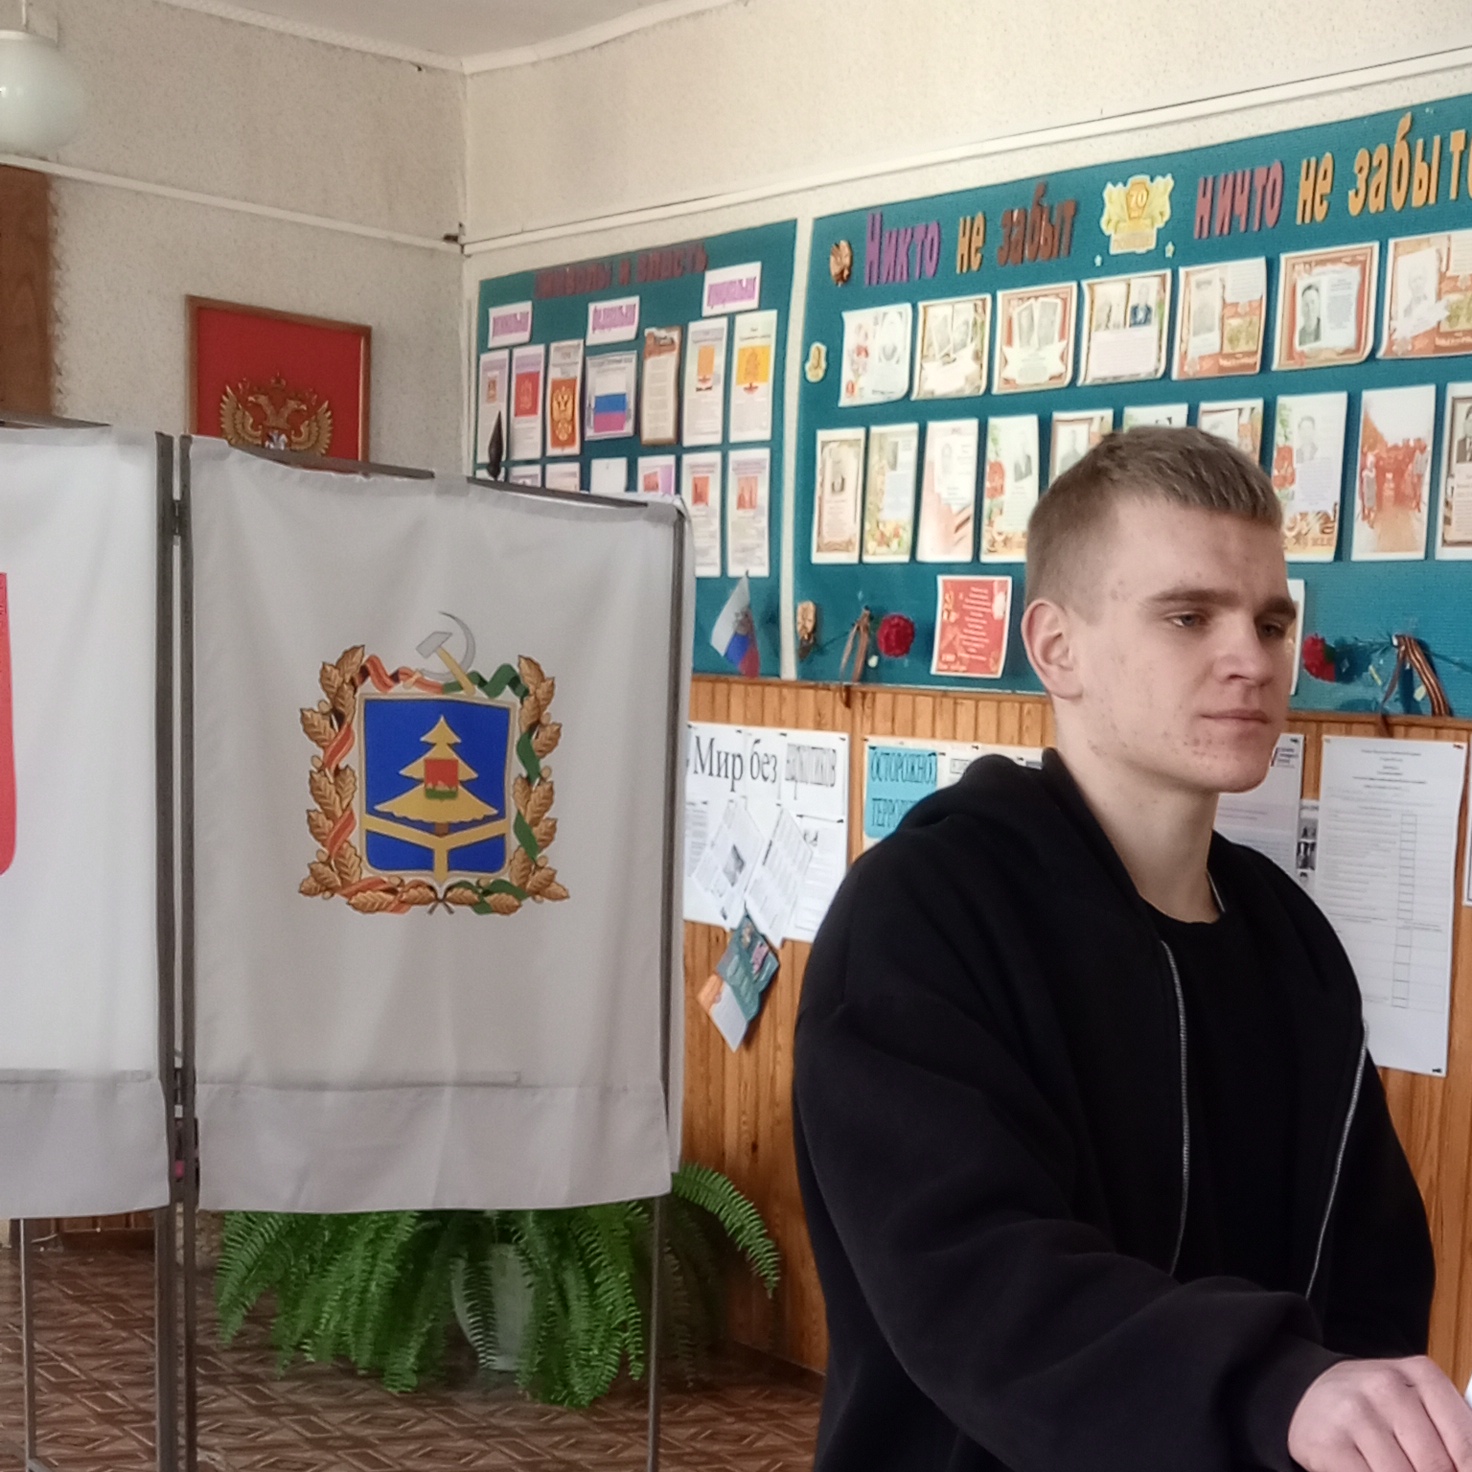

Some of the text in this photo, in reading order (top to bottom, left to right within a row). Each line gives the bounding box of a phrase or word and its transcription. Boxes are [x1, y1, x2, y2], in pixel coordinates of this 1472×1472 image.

[864, 181, 1077, 287] Никто не забыт
[1193, 160, 1284, 240] ничто
[1296, 151, 1335, 226] не
[693, 735, 744, 793] Мир
[749, 738, 778, 784] без
